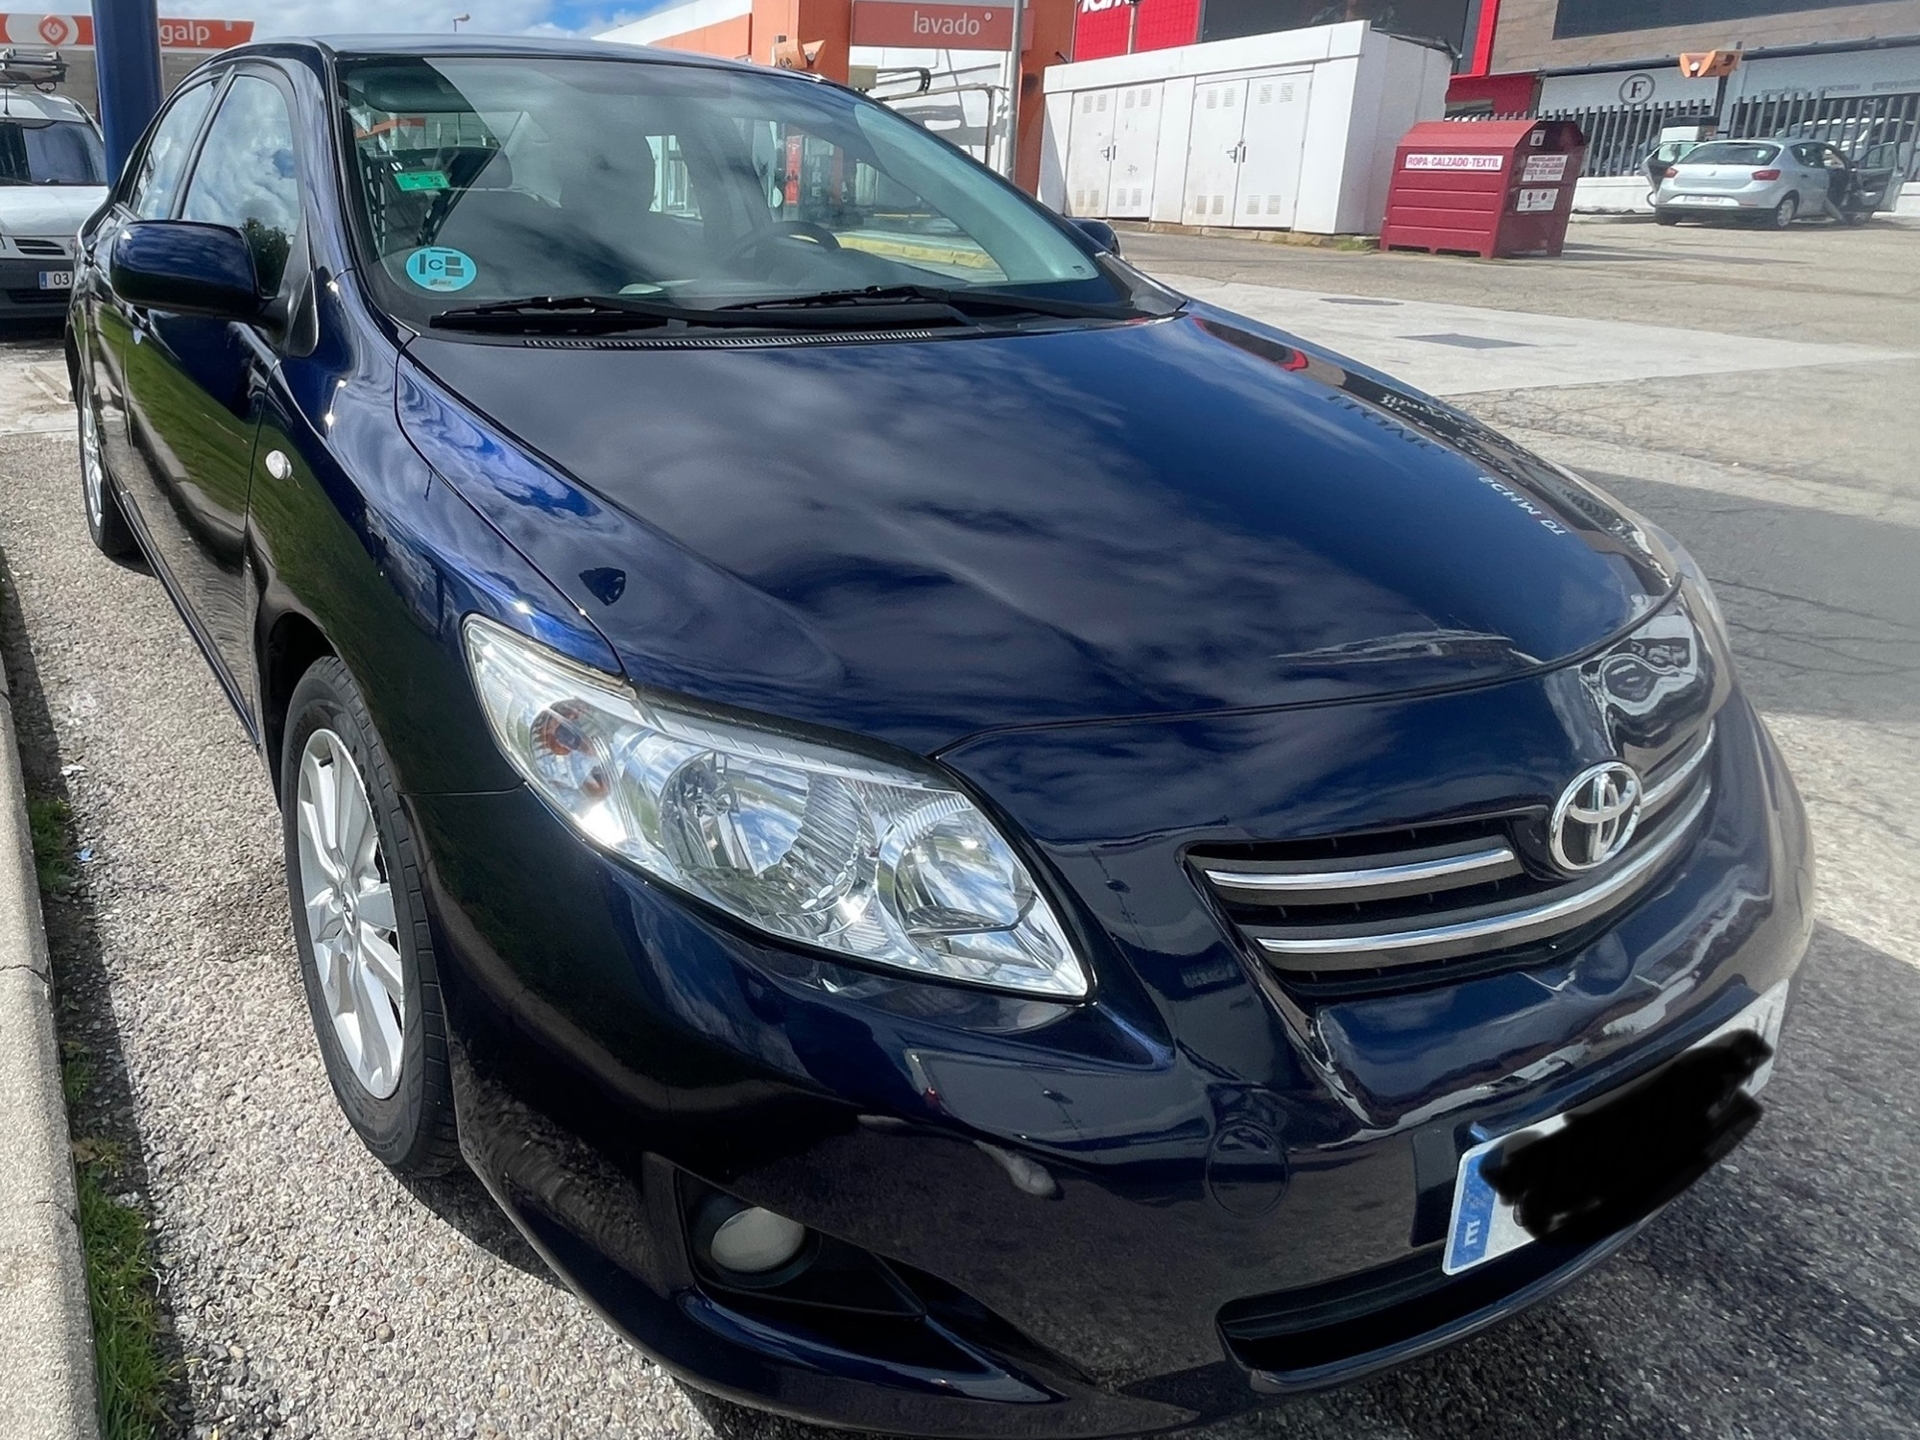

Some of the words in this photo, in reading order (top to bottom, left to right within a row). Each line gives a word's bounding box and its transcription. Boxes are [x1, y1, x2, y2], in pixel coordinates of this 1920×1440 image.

[160, 21, 211, 46] galp
[913, 10, 980, 36] lavado
[1629, 80, 1647, 99] F
[428, 259, 444, 271] C
[53, 272, 70, 286] 03
[1464, 1219, 1481, 1247] E
